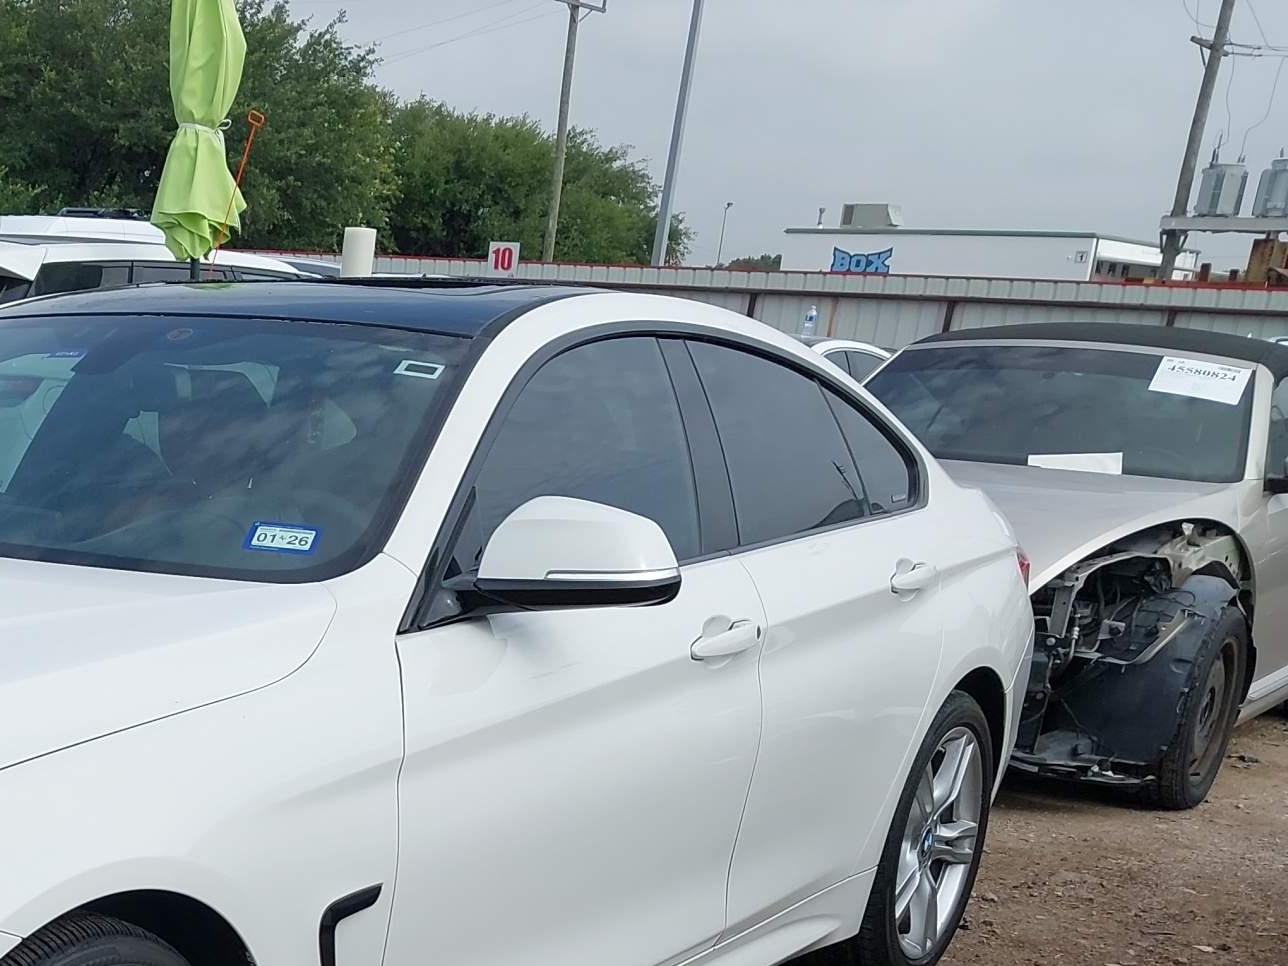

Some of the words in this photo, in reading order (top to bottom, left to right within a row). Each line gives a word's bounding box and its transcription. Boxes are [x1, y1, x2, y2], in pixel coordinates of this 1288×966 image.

[492, 247, 513, 271] 10
[831, 246, 893, 273] BOX
[256, 532, 278, 543] 01
[286, 535, 310, 546] 26
